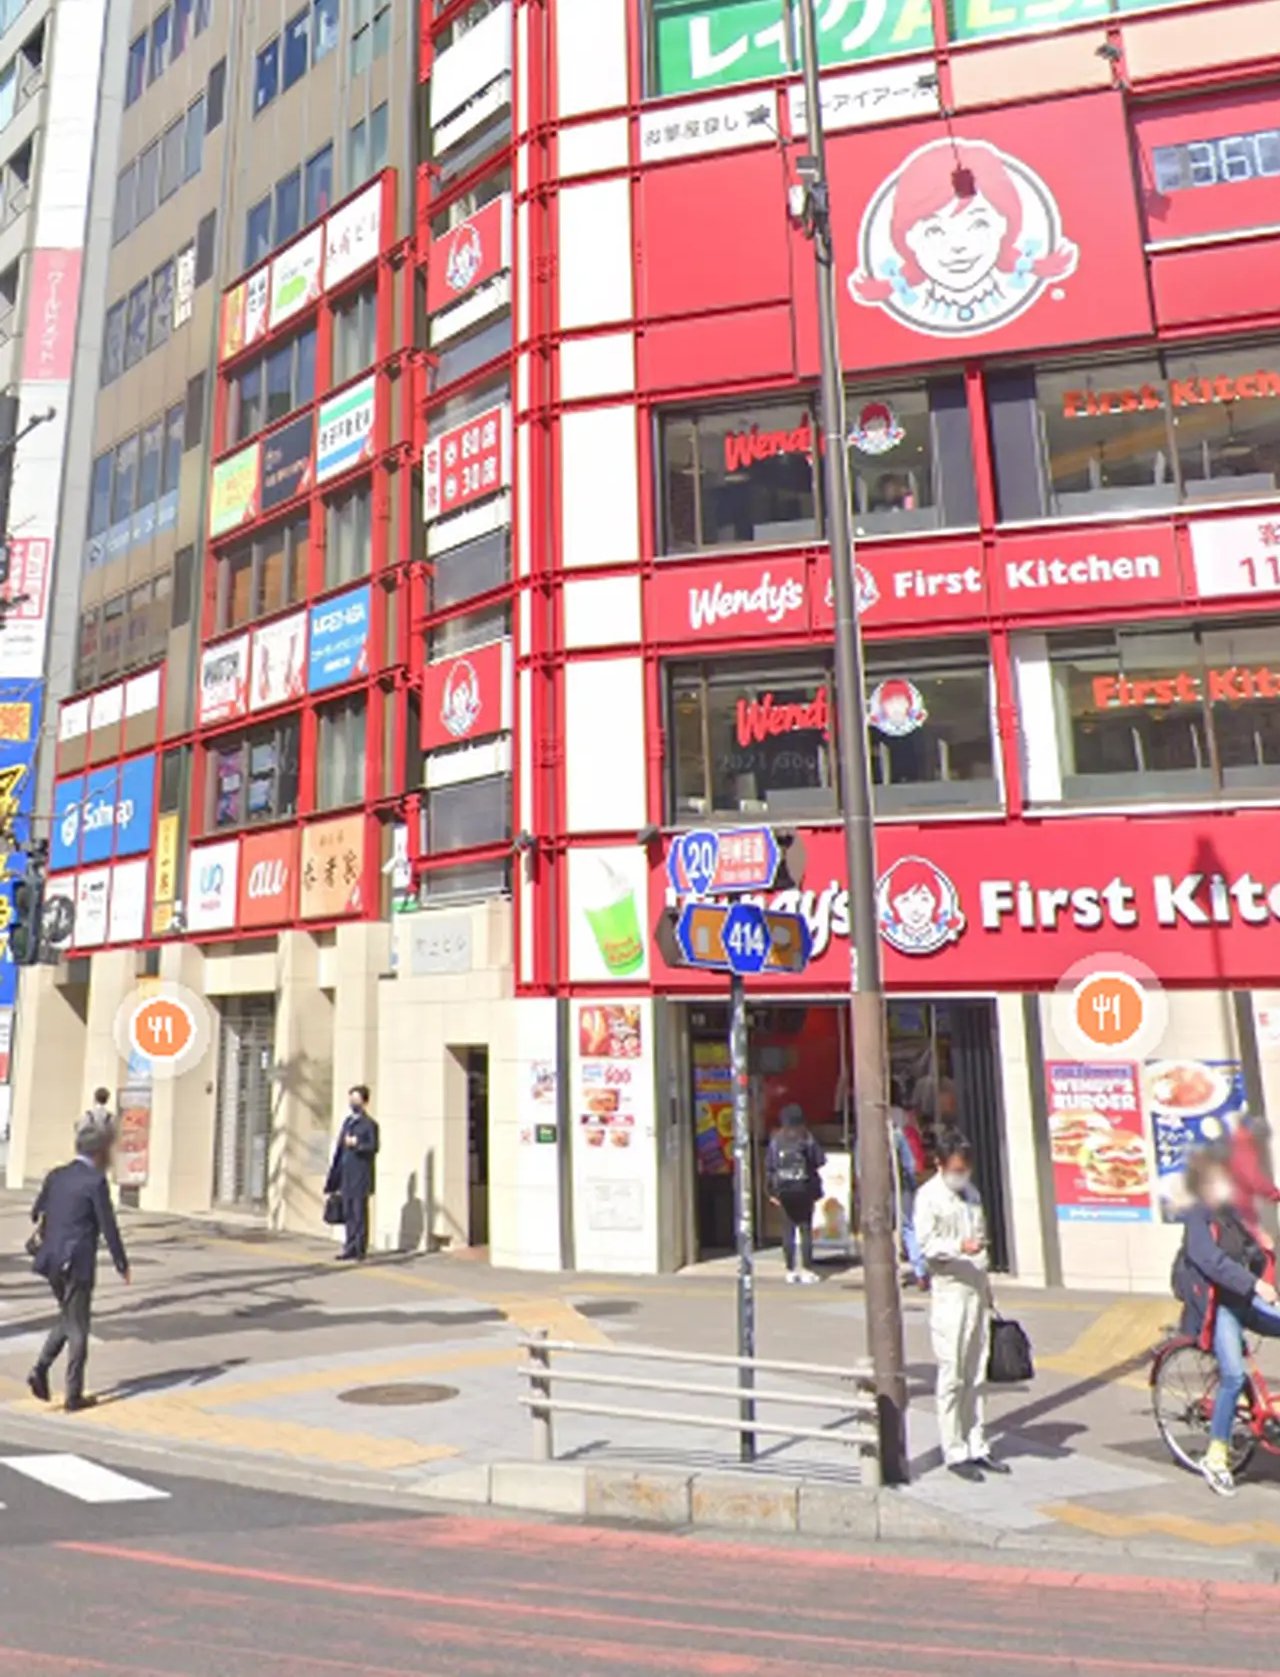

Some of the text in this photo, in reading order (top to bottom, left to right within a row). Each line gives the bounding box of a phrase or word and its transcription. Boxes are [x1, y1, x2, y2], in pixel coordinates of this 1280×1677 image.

[1063, 384, 1161, 419] First
[895, 551, 1160, 599] First Kitchen
[689, 573, 803, 629] Wendy's
[1092, 672, 1199, 709] First
[248, 857, 288, 899] au
[688, 841, 712, 878] 20
[980, 879, 1136, 933] First
[728, 921, 765, 957] 414
[1052, 1094, 1137, 1111] BURGER
